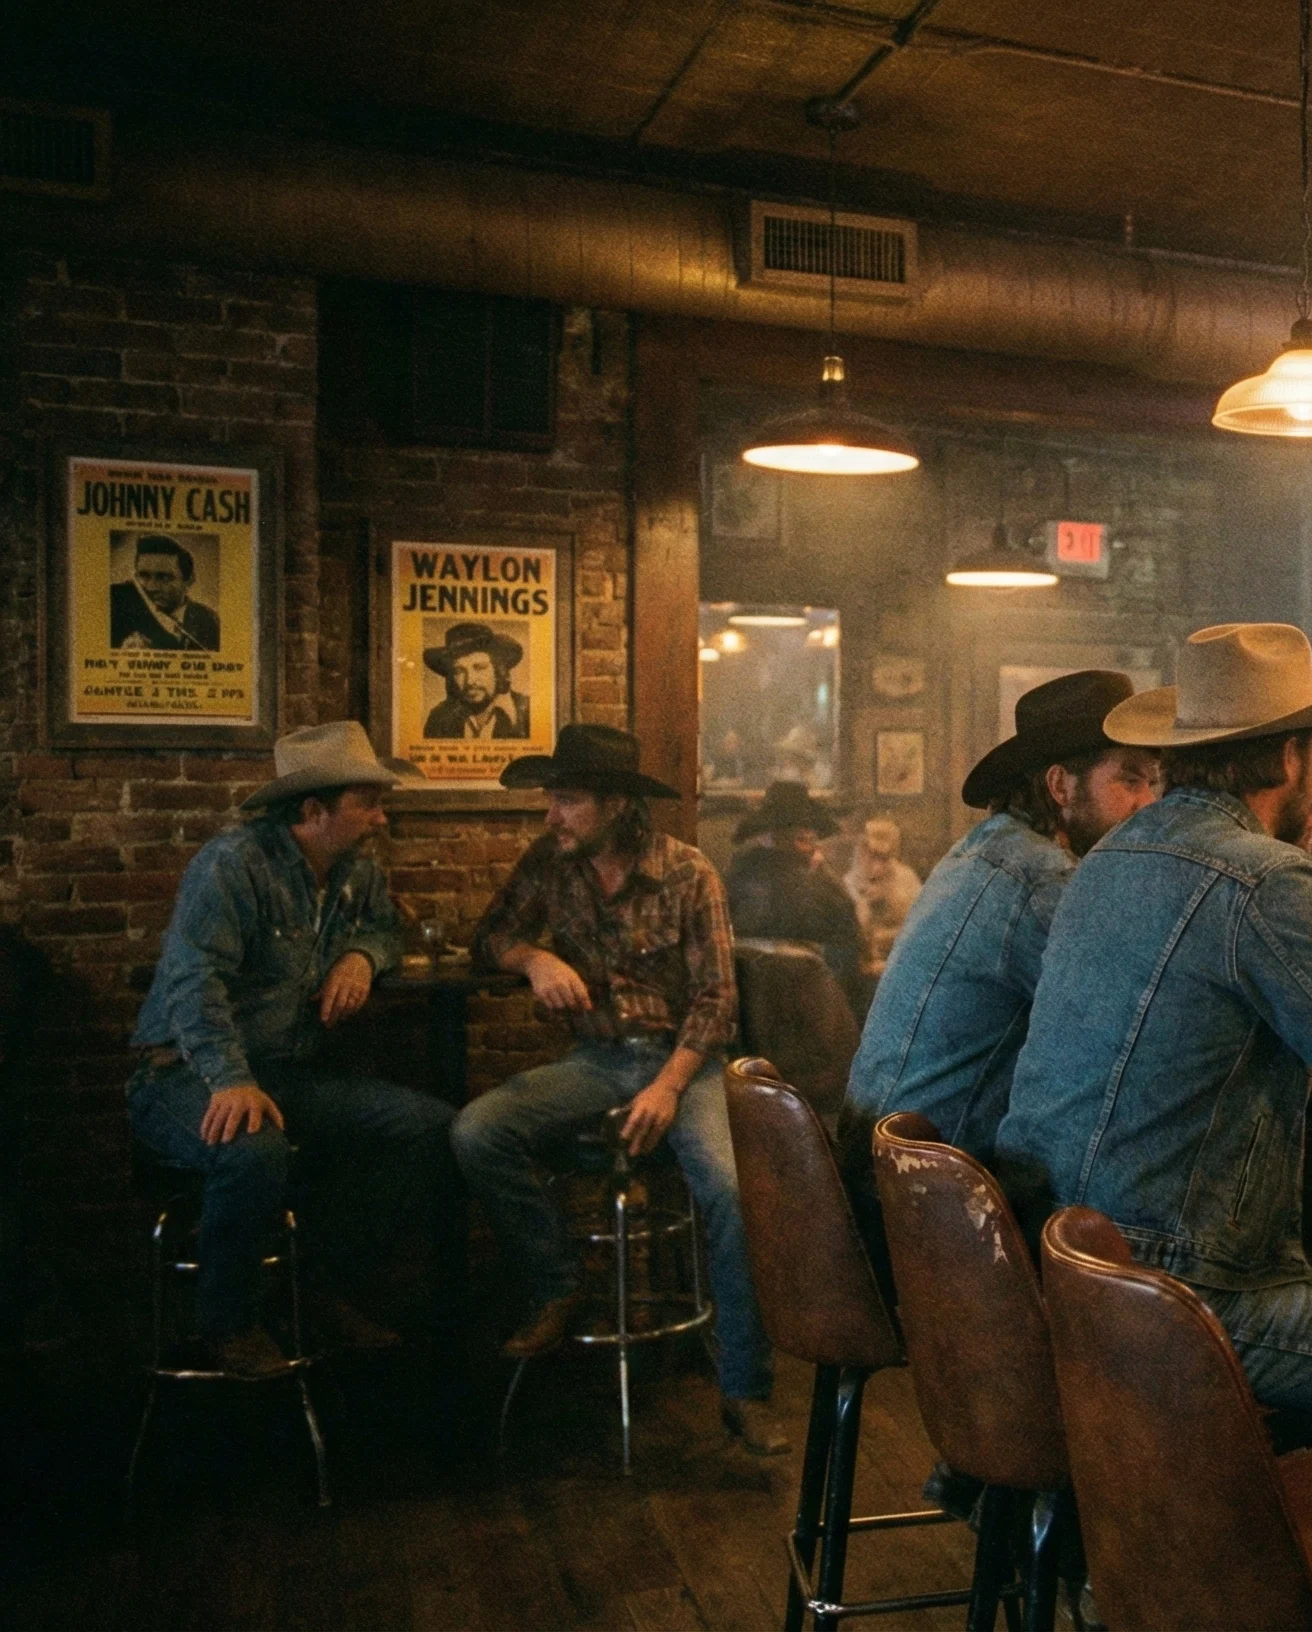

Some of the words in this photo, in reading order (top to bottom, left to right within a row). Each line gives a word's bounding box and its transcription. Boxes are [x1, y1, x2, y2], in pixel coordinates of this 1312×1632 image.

[77, 481, 176, 519] JOHNNY
[186, 488, 250, 524] CASH
[411, 552, 541, 583] WAYLON
[403, 584, 549, 615] JENNINGS
